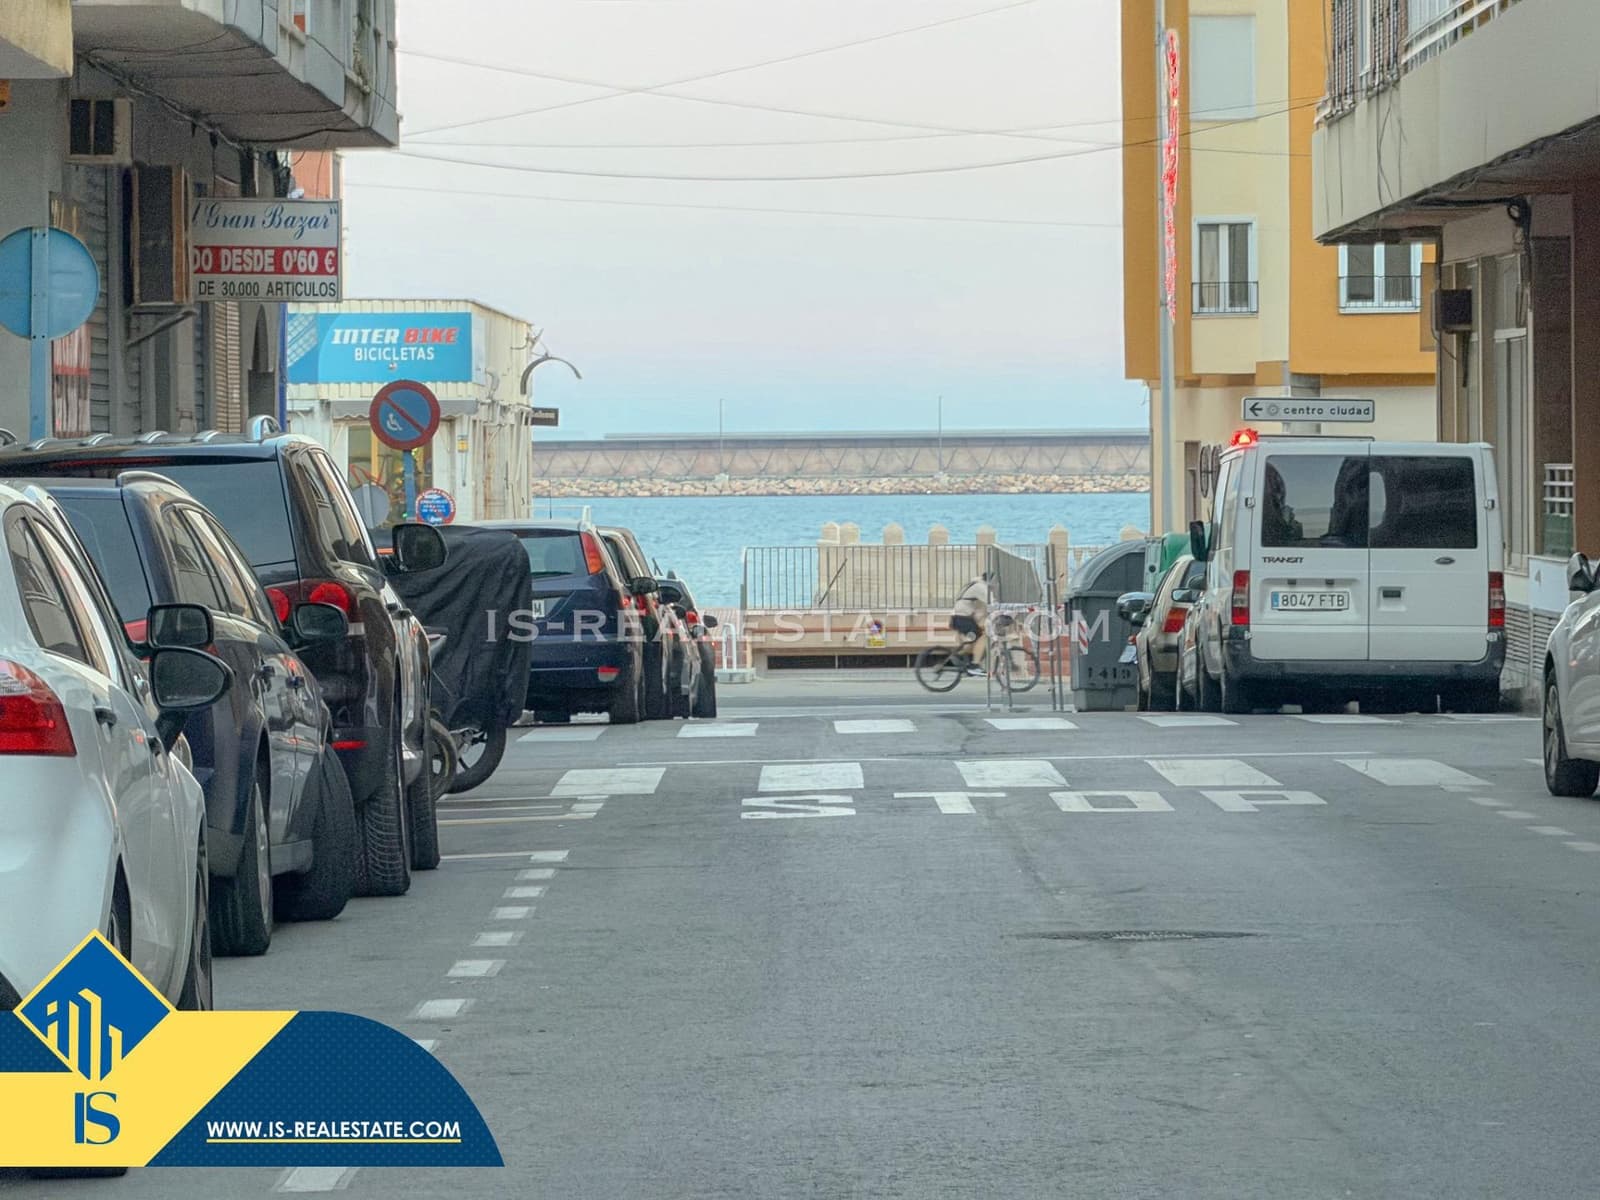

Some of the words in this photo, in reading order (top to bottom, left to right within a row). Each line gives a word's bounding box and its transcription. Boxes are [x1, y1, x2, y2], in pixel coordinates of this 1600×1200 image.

[220, 249, 275, 272] DESDE
[324, 250, 336, 273] €
[199, 281, 215, 296] DE
[222, 281, 260, 297] 30.000
[266, 281, 337, 297] ARTICULOS
[331, 328, 400, 345] INTER
[404, 327, 459, 345] BIKE
[354, 347, 435, 361] BICICLETAS
[1283, 405, 1324, 415] centro
[1329, 405, 1370, 416] ciudad
[1281, 594, 1315, 607] 8047
[1319, 594, 1345, 607] FTB
[741, 791, 1328, 819] STOP
